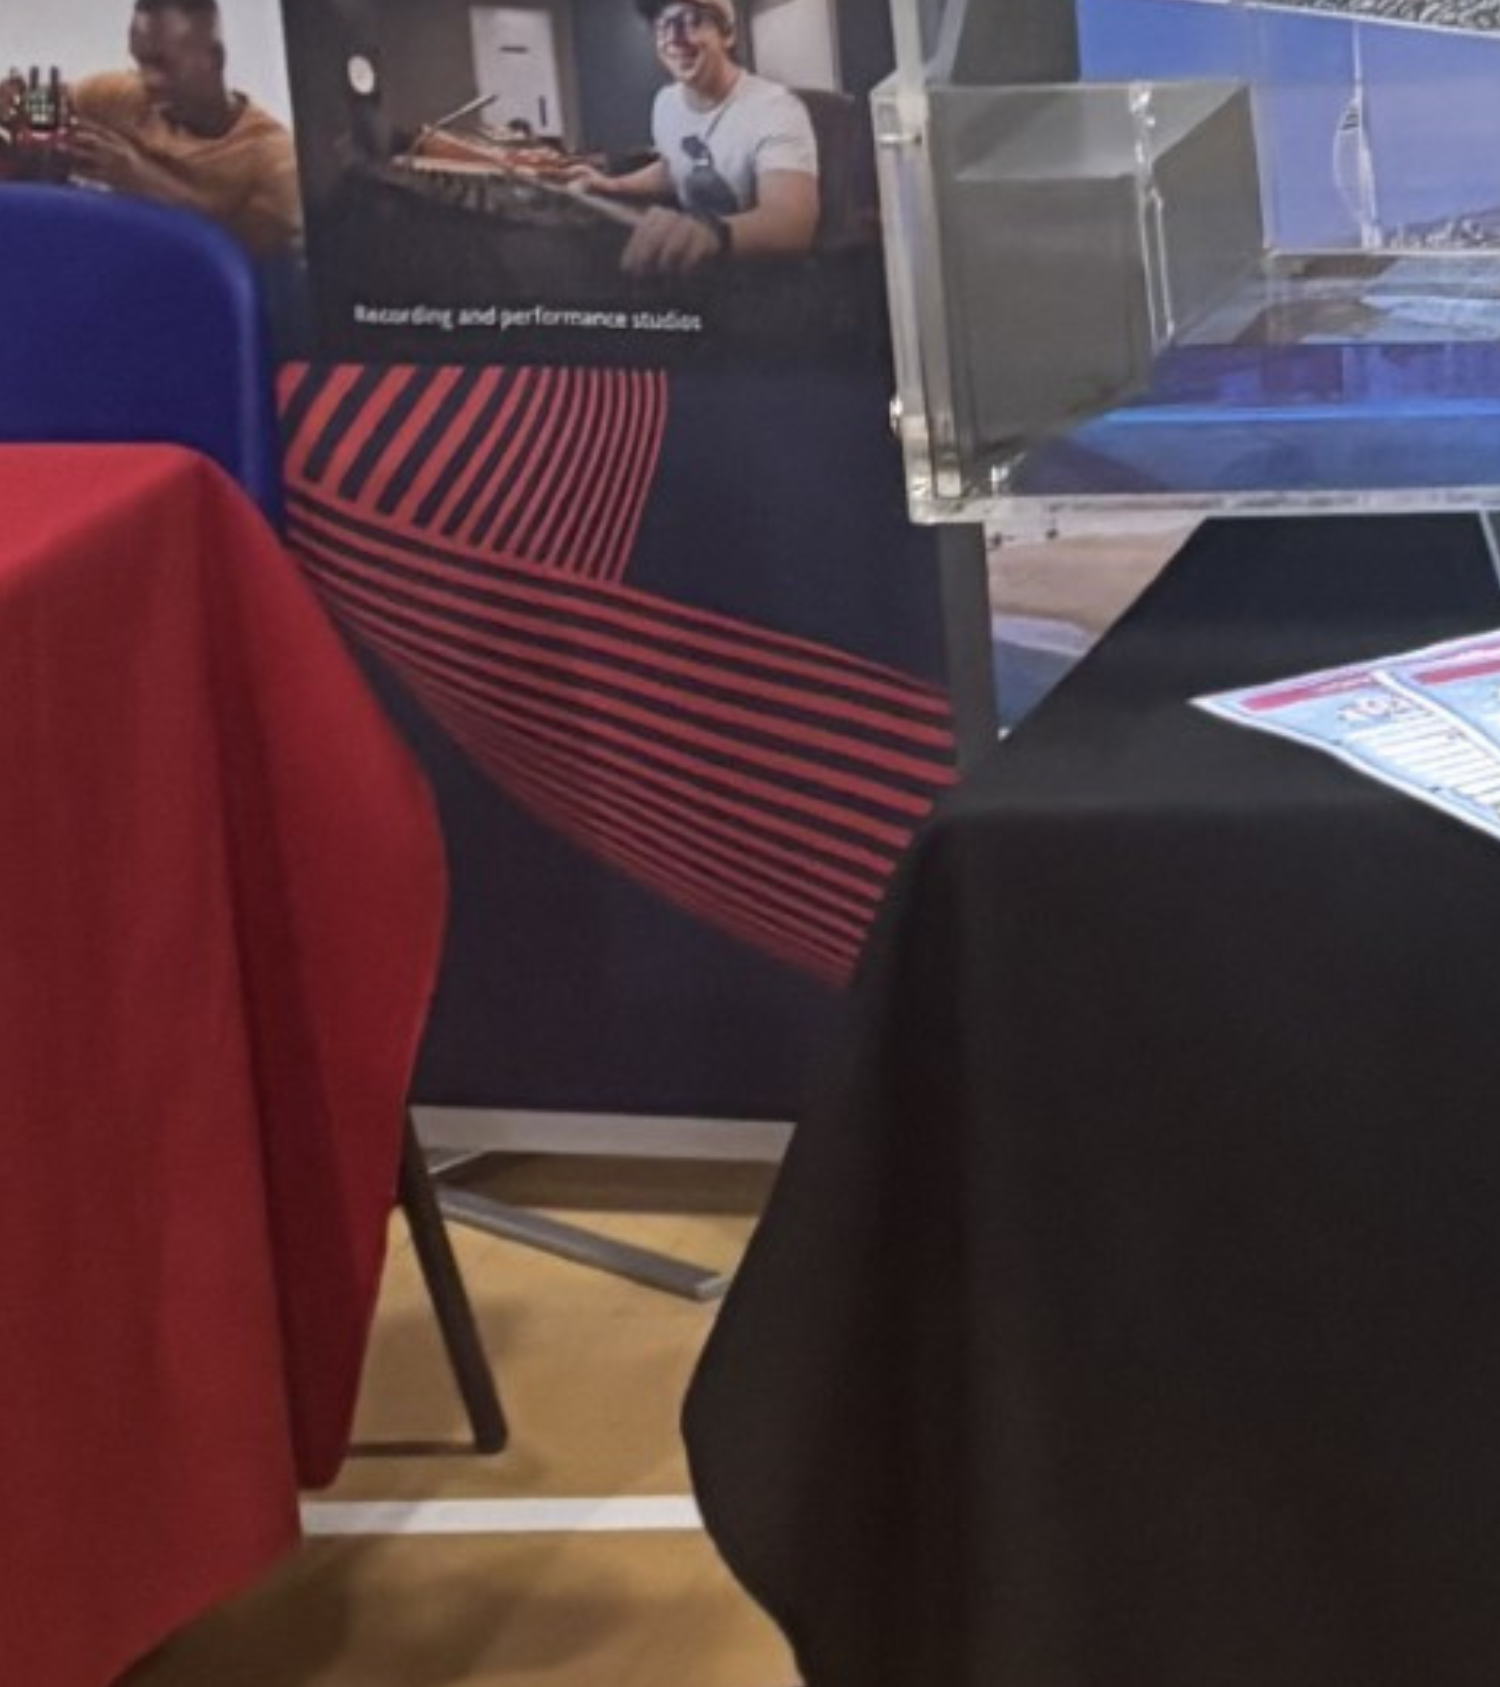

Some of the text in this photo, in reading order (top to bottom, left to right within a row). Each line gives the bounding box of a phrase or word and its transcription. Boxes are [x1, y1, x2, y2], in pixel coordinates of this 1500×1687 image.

[354, 304, 703, 332] Recording and performance studios
